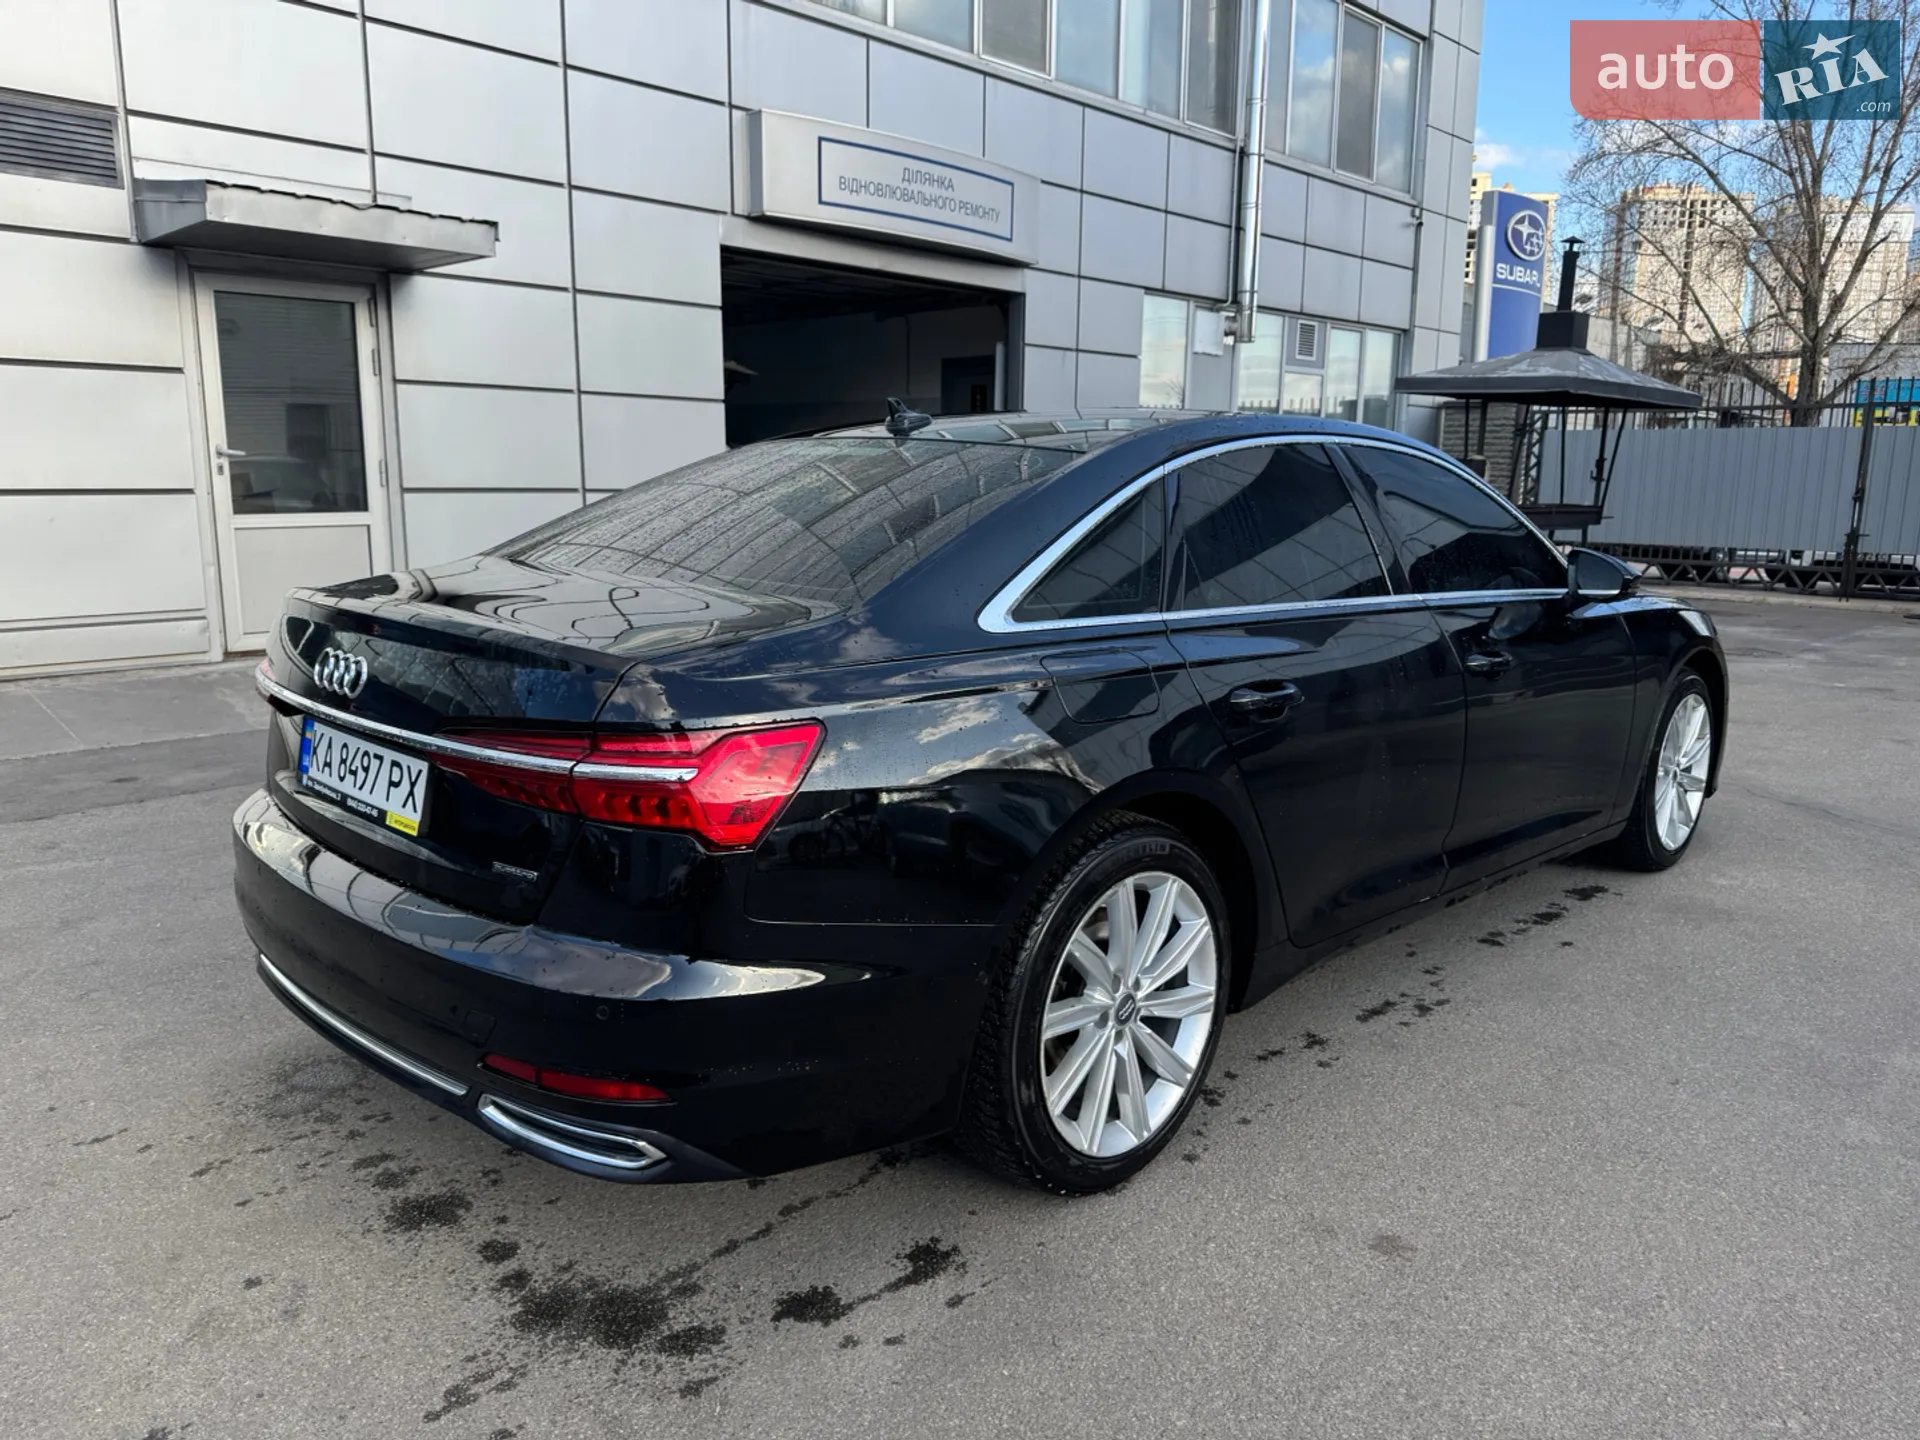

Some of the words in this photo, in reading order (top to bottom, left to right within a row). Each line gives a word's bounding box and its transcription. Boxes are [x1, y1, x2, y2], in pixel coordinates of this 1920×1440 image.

[838, 175, 957, 213] ВІДНОВЛЮВАЛЬНОГО
[958, 202, 1001, 224] РЕМОНТУ
[901, 167, 955, 192] ДІЛЯНКА
[310, 730, 333, 778] KA
[338, 742, 384, 795] 8497
[386, 759, 423, 813] PX
